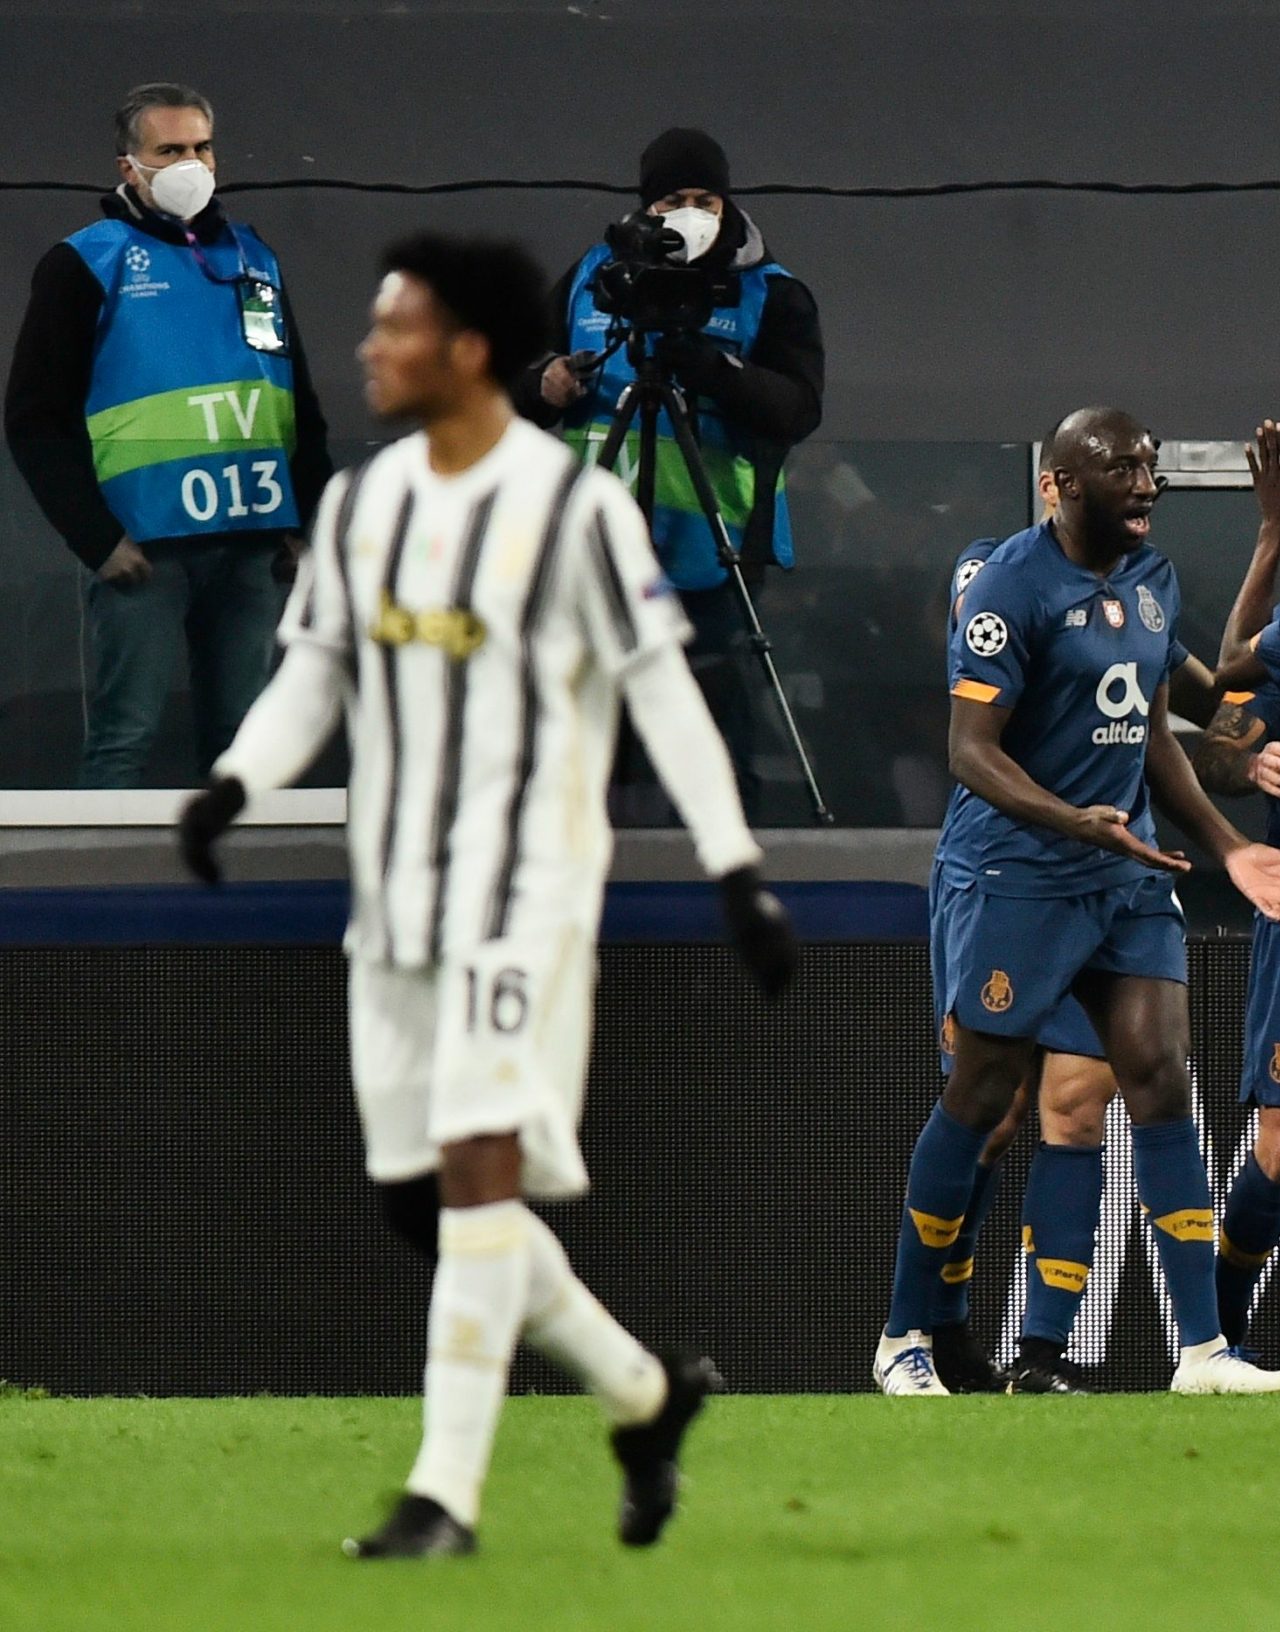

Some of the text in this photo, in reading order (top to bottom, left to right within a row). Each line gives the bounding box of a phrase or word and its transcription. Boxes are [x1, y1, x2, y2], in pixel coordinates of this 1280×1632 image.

[188, 388, 261, 443] TV
[181, 460, 283, 521] 013
[1092, 721, 1145, 745] altice
[464, 964, 529, 1036] 16
